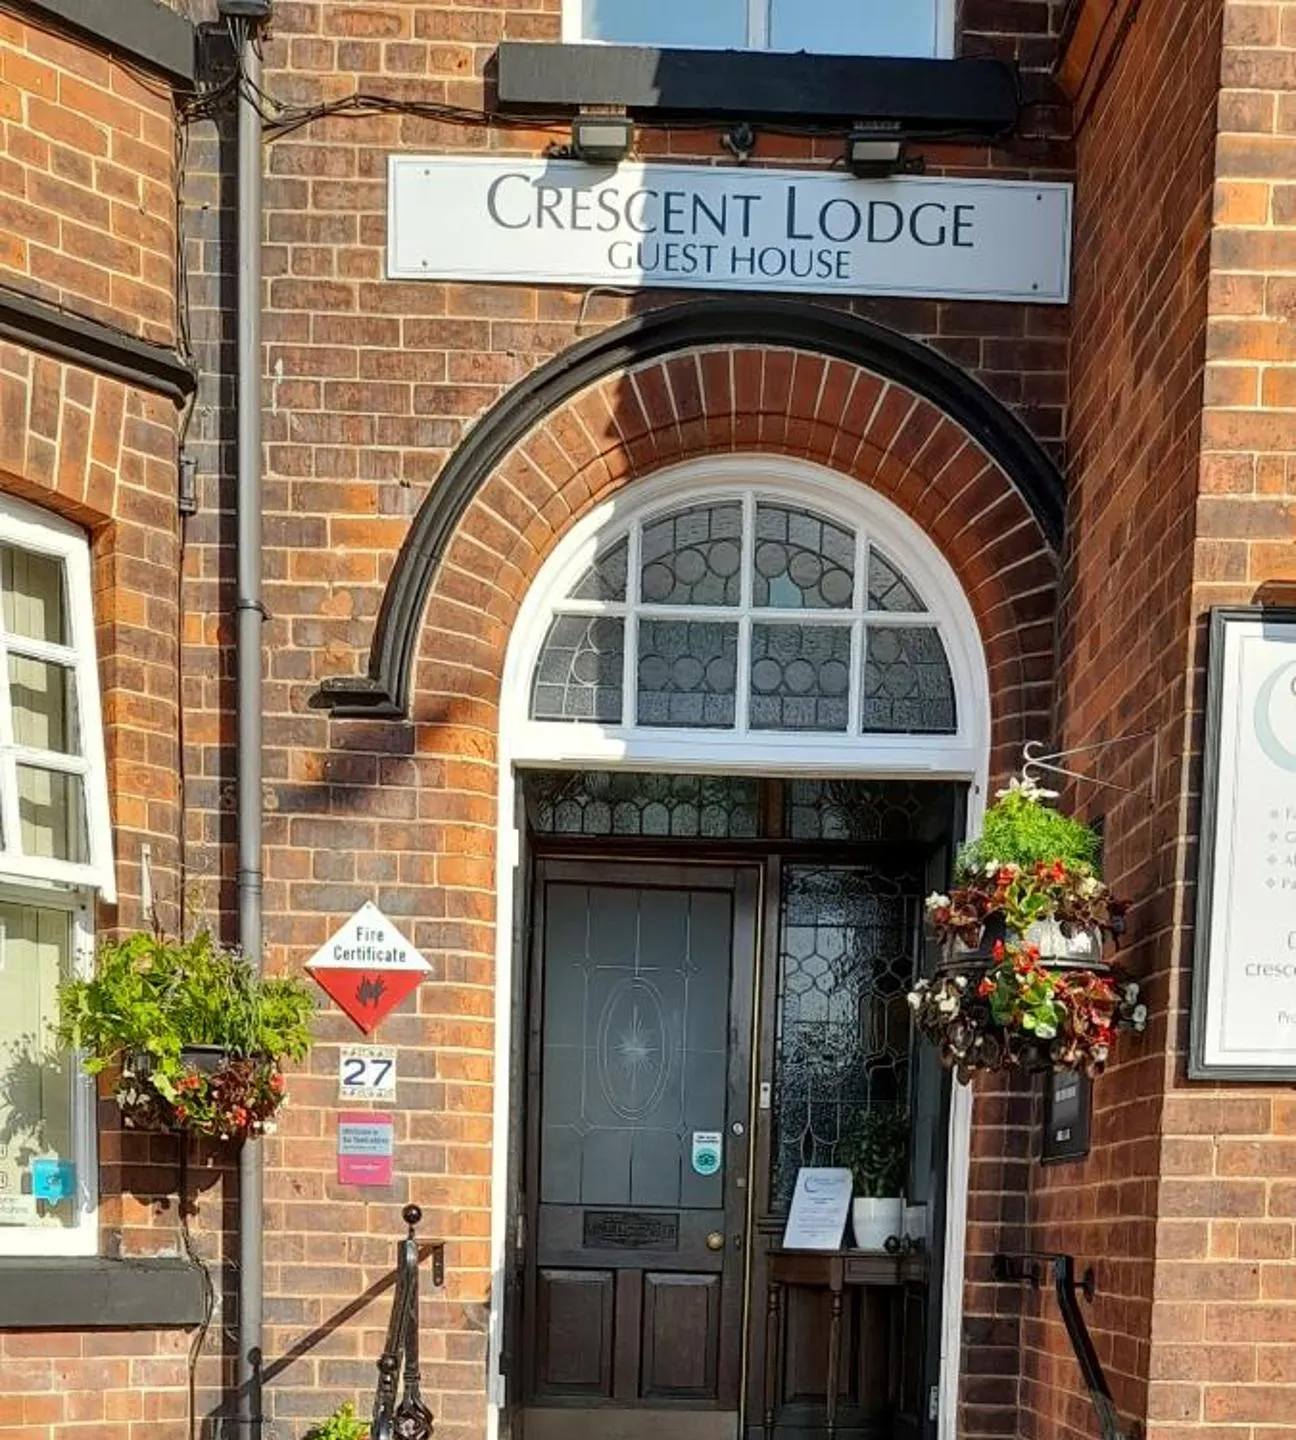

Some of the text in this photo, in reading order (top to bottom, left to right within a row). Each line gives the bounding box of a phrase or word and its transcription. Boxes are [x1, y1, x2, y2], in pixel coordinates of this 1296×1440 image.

[486, 173, 976, 247] CRESCENT LODGE
[607, 240, 852, 279] GUEST HOUSE
[356, 925, 384, 942] Fire
[333, 944, 407, 963] Certificate
[343, 1058, 393, 1087] 27
